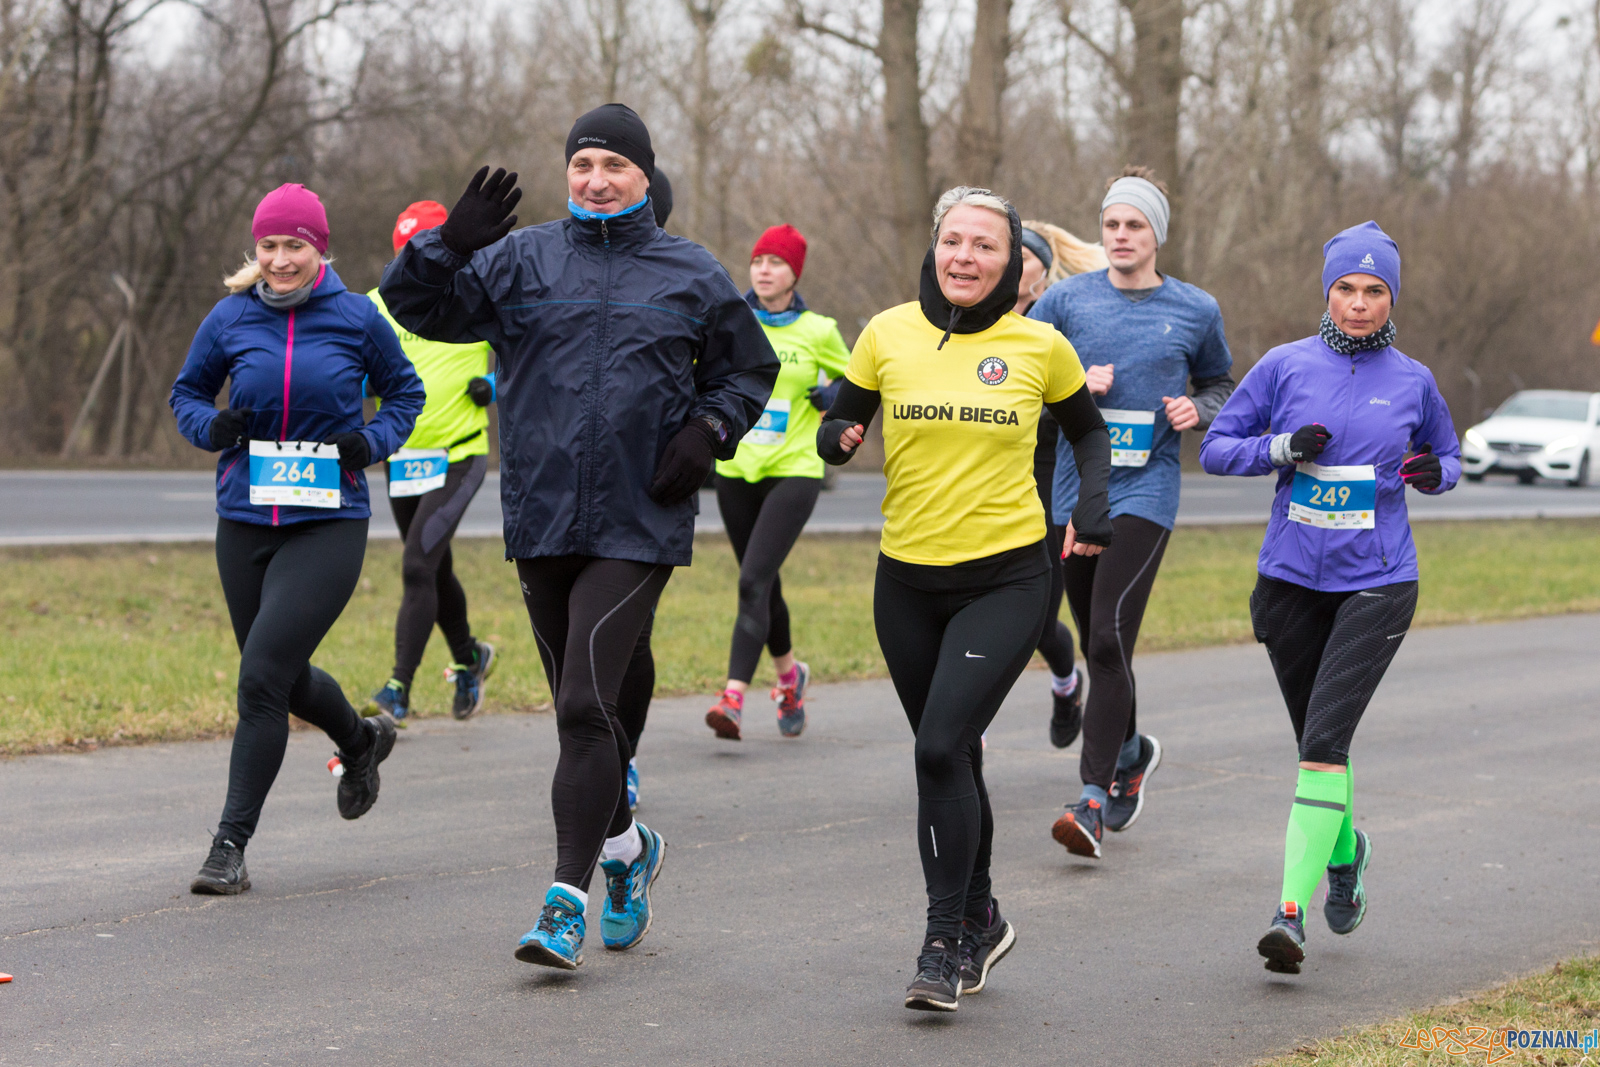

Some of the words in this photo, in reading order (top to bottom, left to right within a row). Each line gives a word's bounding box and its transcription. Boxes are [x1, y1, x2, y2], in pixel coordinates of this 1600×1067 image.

[893, 402, 953, 421] LUBOŃ
[959, 406, 1019, 426] BIEGA
[271, 461, 316, 483] 264
[404, 460, 433, 478] 229
[1309, 484, 1351, 506] 249
